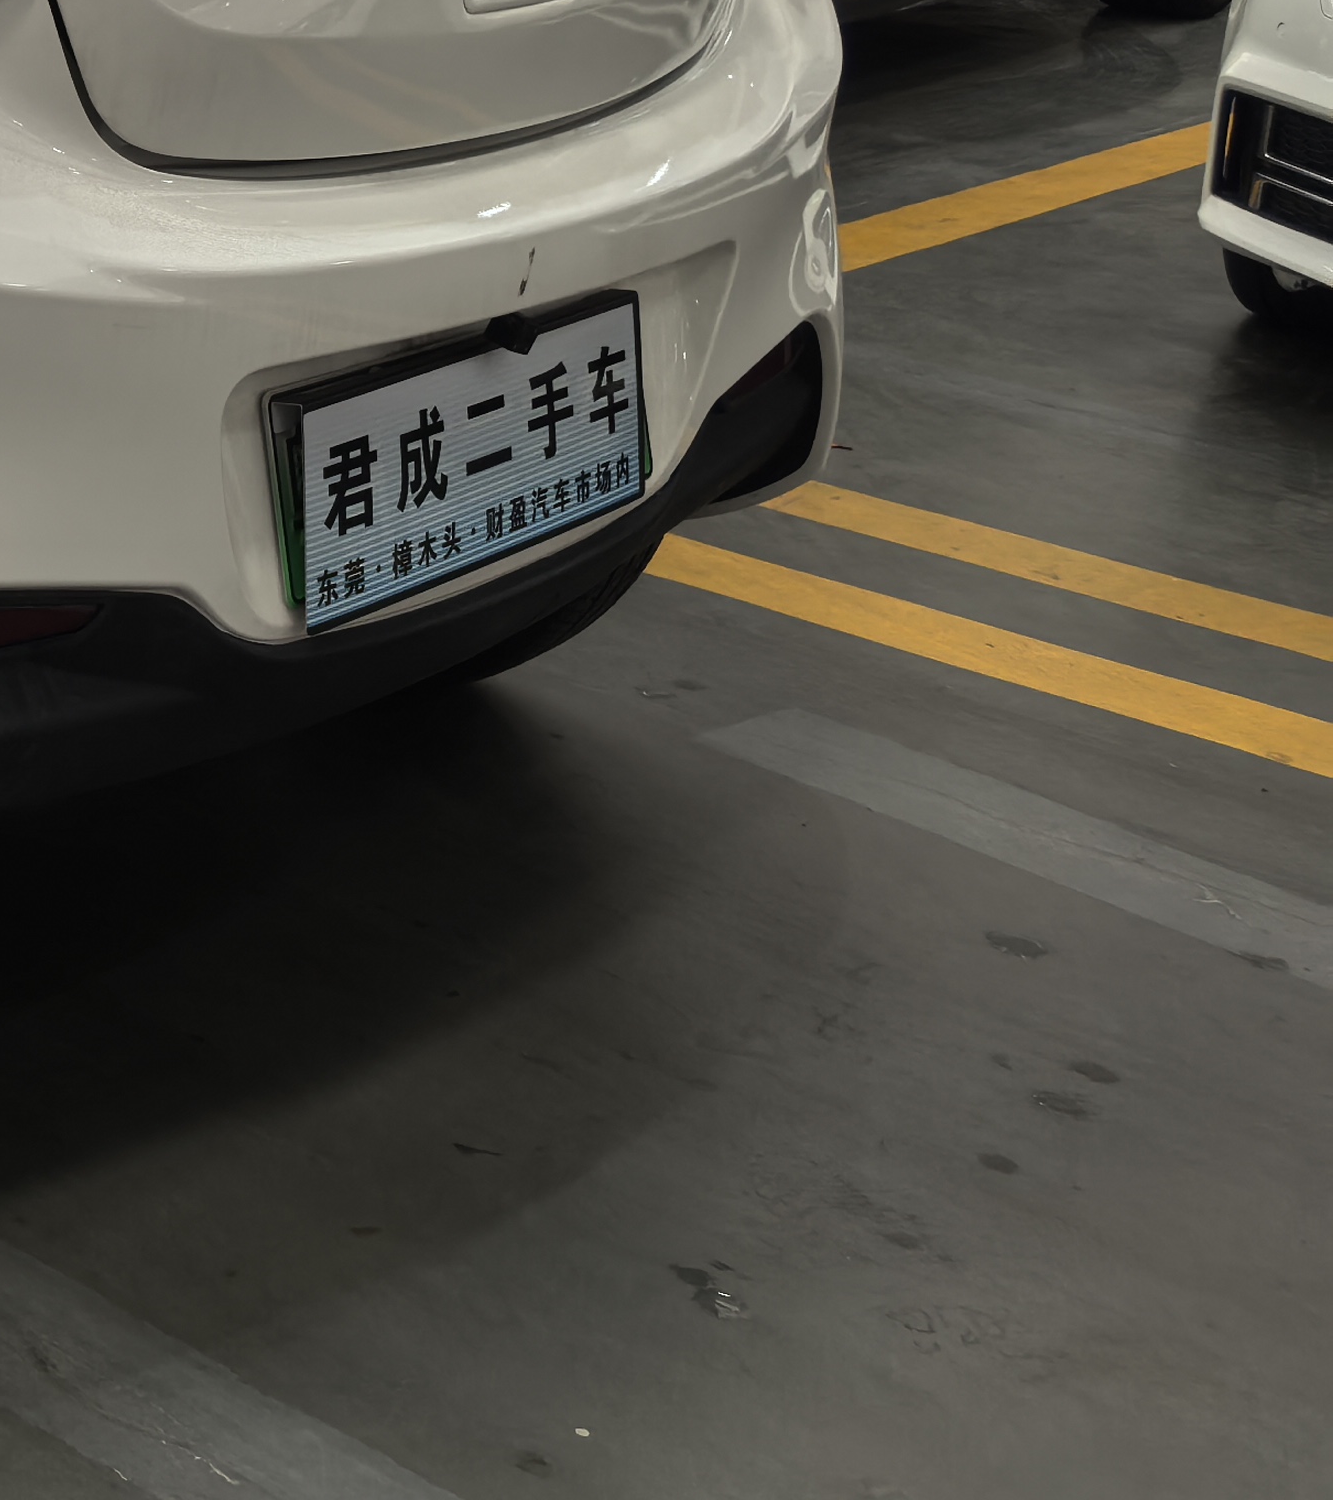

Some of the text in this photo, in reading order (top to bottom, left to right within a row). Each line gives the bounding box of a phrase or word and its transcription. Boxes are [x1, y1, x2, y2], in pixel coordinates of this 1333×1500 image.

[322, 345, 630, 538] 君成二手车
